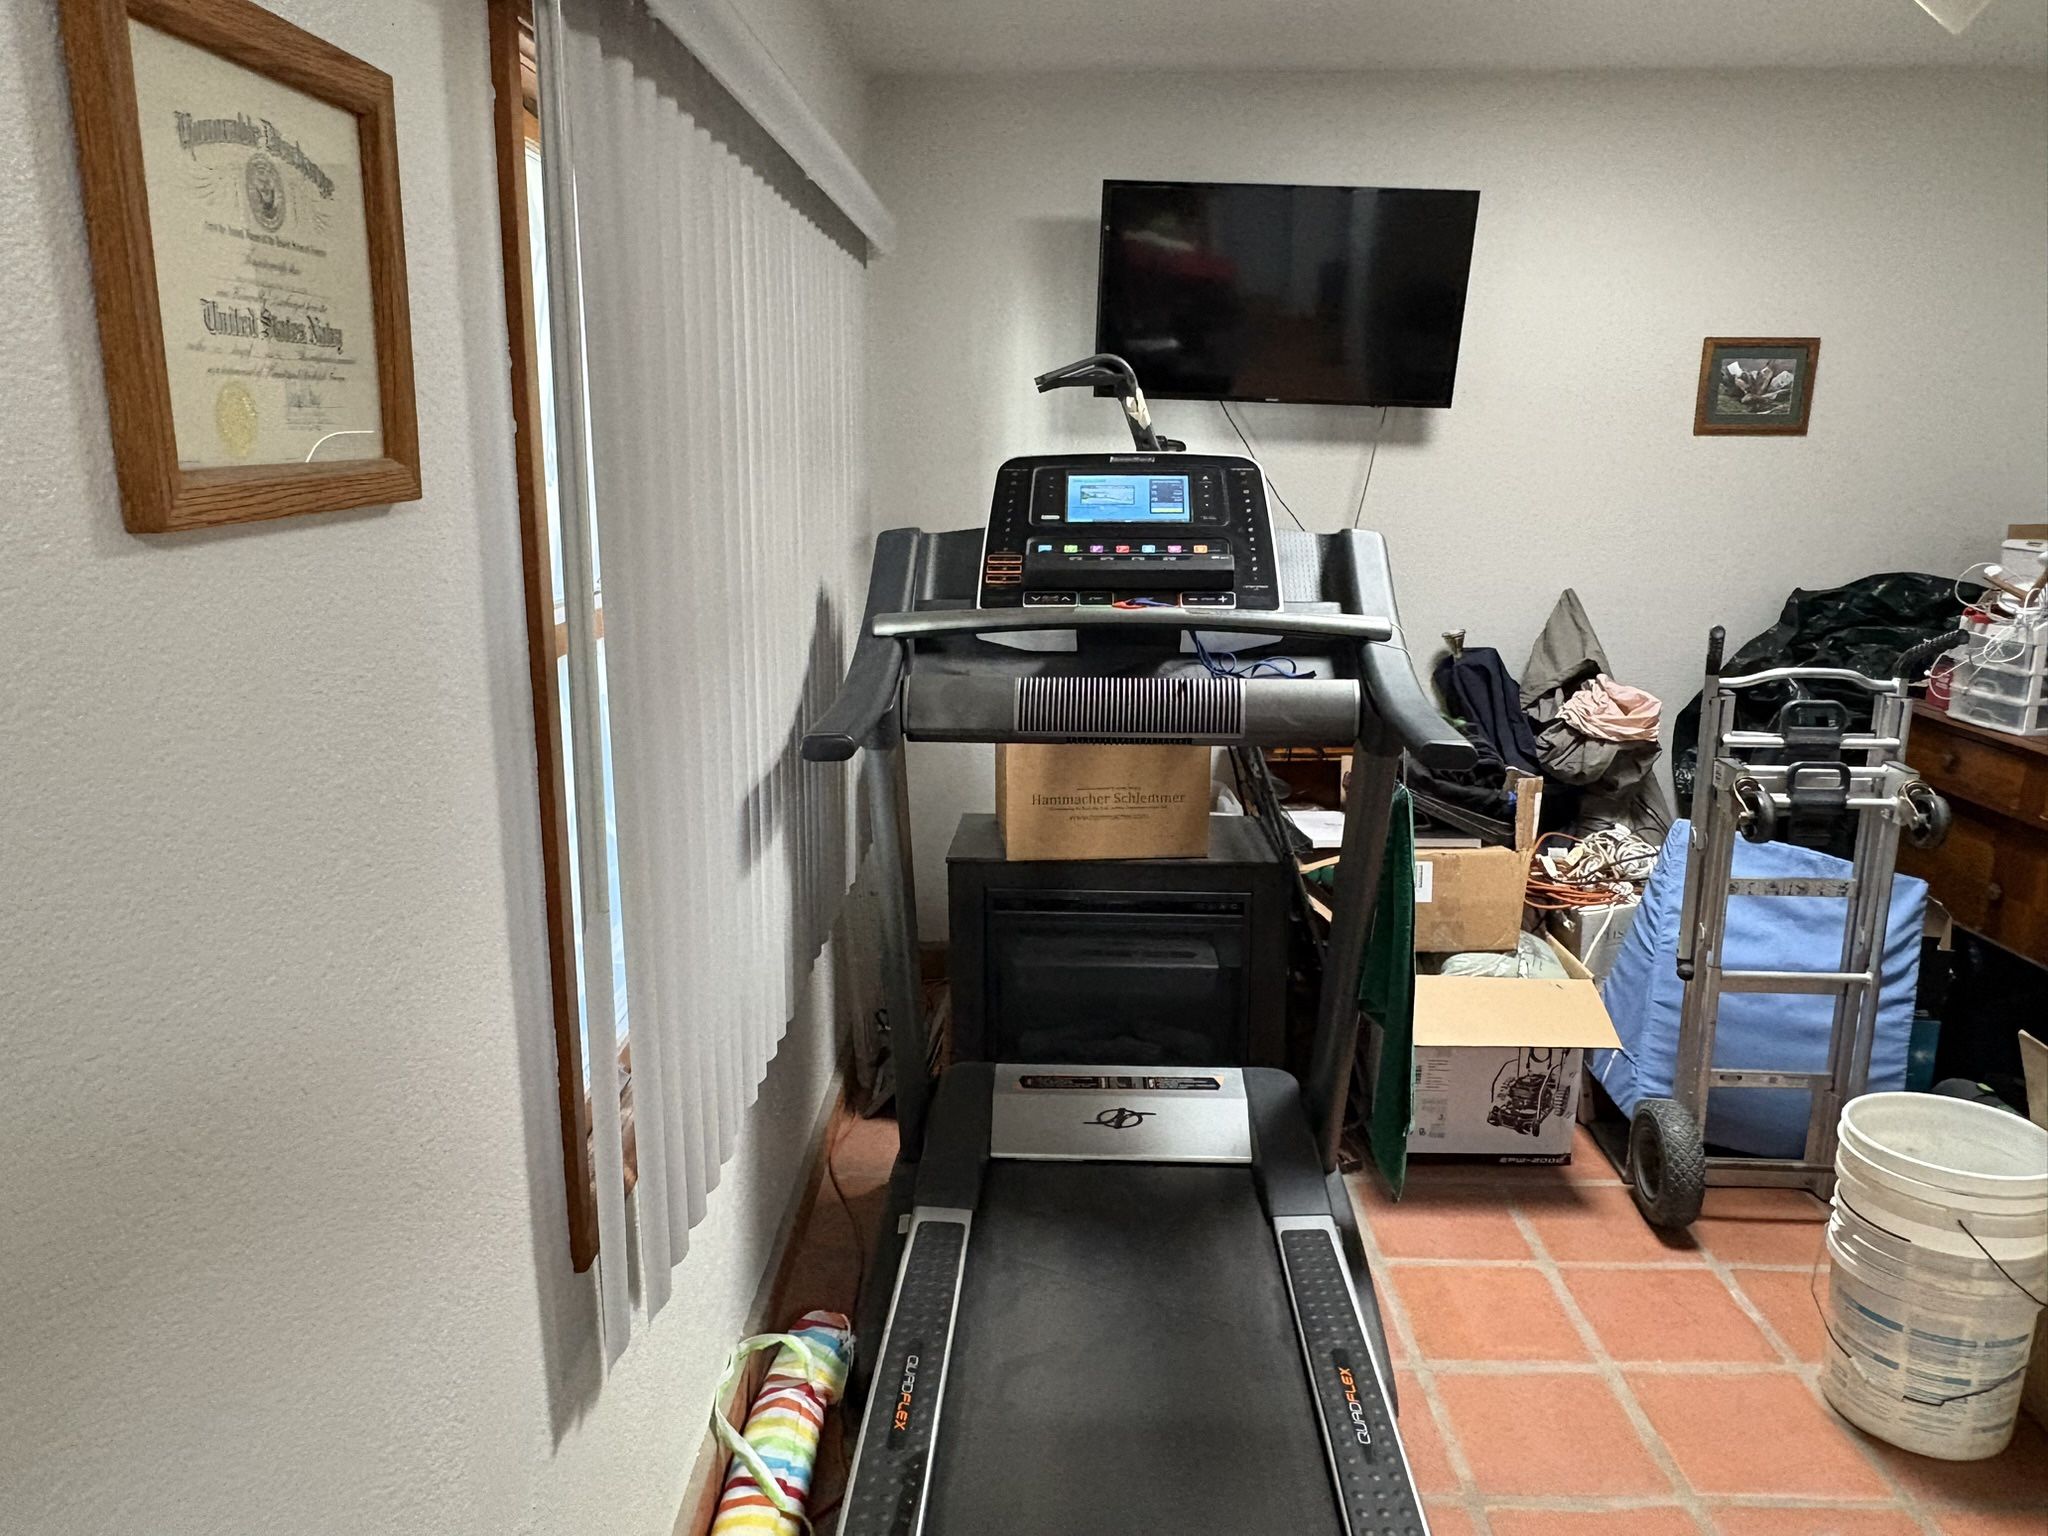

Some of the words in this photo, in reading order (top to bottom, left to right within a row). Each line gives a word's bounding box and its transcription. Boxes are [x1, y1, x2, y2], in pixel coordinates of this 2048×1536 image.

[1032, 792, 1110, 806] Hammacher
[1113, 791, 1186, 804] Schlemmer
[893, 1355, 919, 1431] QUADFLEX
[1338, 1366, 1371, 1445] QUADFLEX
